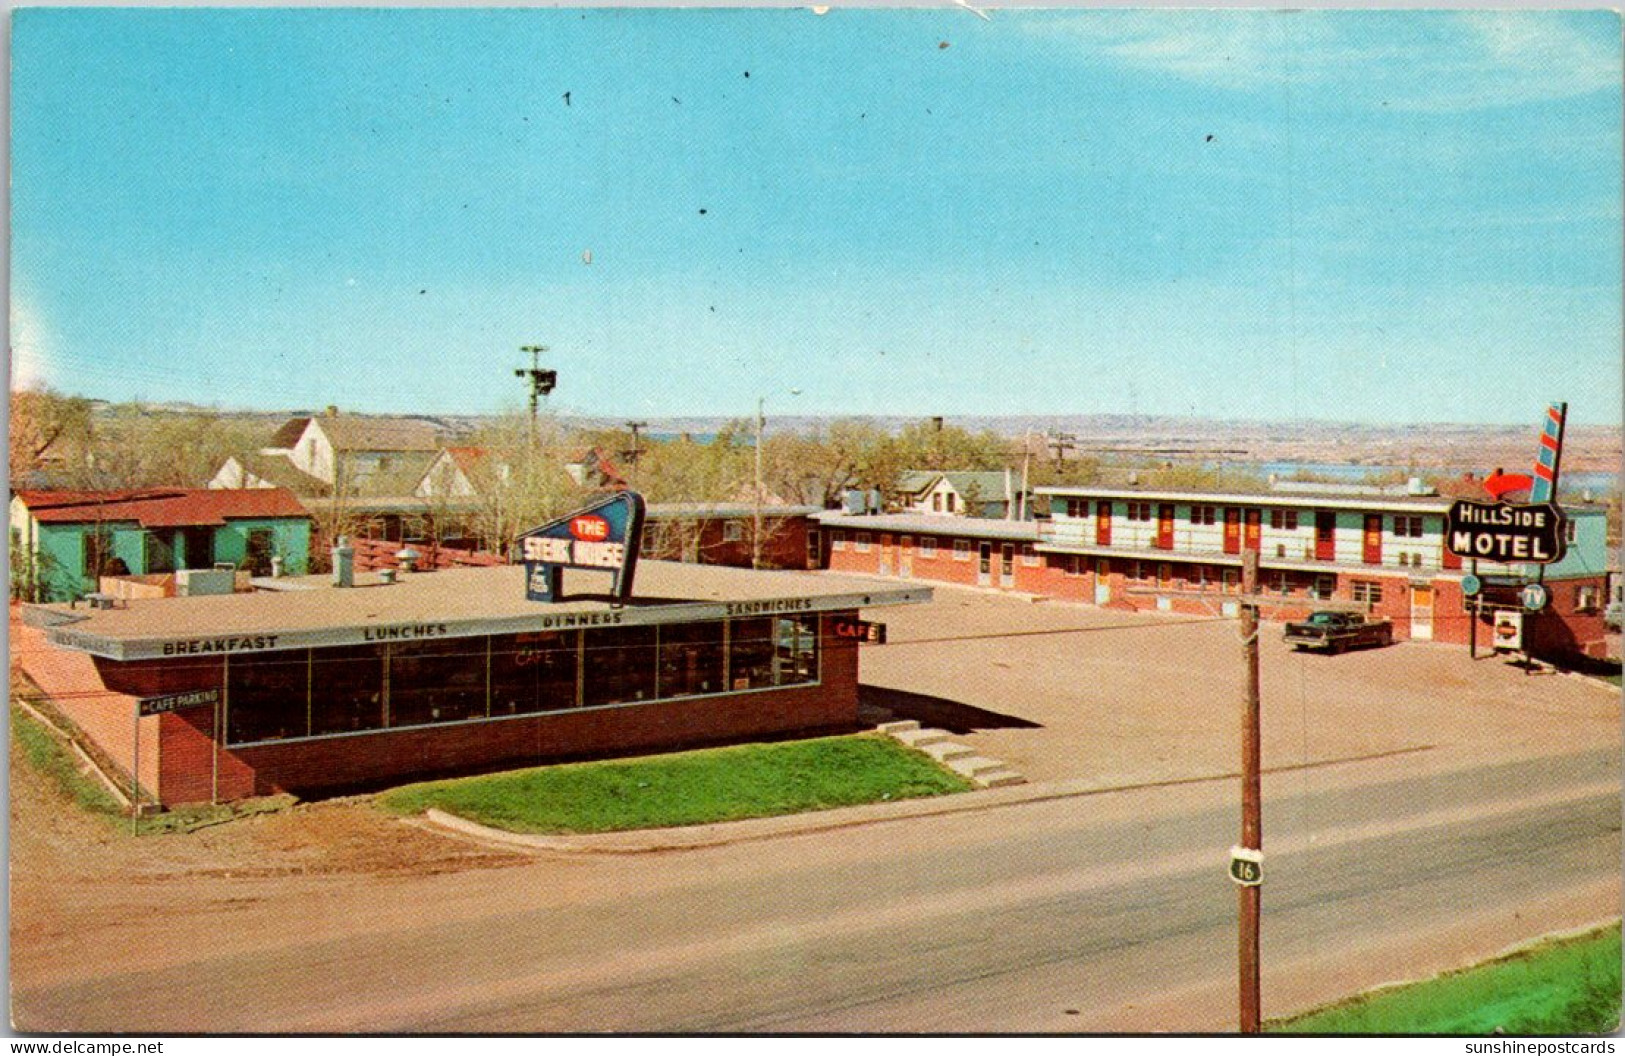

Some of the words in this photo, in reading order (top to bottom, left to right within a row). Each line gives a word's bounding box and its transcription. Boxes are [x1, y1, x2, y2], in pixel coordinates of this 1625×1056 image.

[576, 519, 605, 536] THE
[523, 536, 570, 564] STEAK
[1453, 531, 1549, 559] MOTEL
[1526, 588, 1542, 602] TV
[726, 598, 812, 615] SANDWICHES
[543, 613, 622, 628] DINNERS
[364, 623, 447, 641] LUNCHES
[836, 621, 878, 641] CAFE
[163, 635, 279, 655] BREAKFAST
[149, 696, 176, 712] CAFE
[1239, 861, 1255, 880] 16
